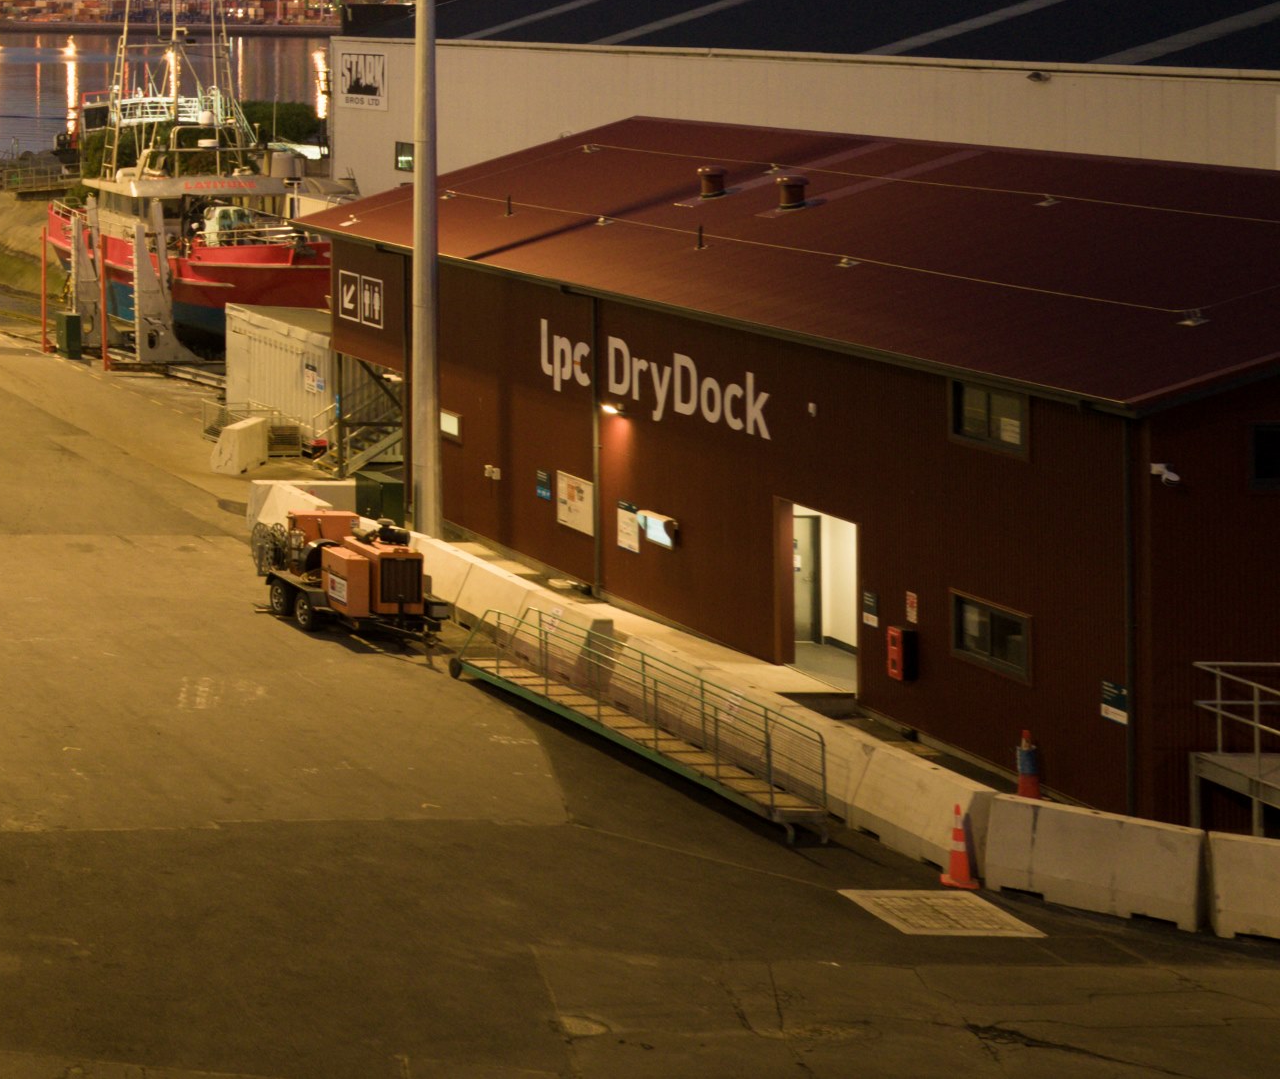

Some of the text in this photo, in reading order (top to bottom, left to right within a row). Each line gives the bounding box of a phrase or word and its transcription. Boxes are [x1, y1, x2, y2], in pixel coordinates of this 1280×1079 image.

[342, 53, 384, 97] STARK
[345, 96, 380, 106] BROS LTD
[184, 180, 257, 190] LATITUDE
[608, 335, 772, 441] DryDock
